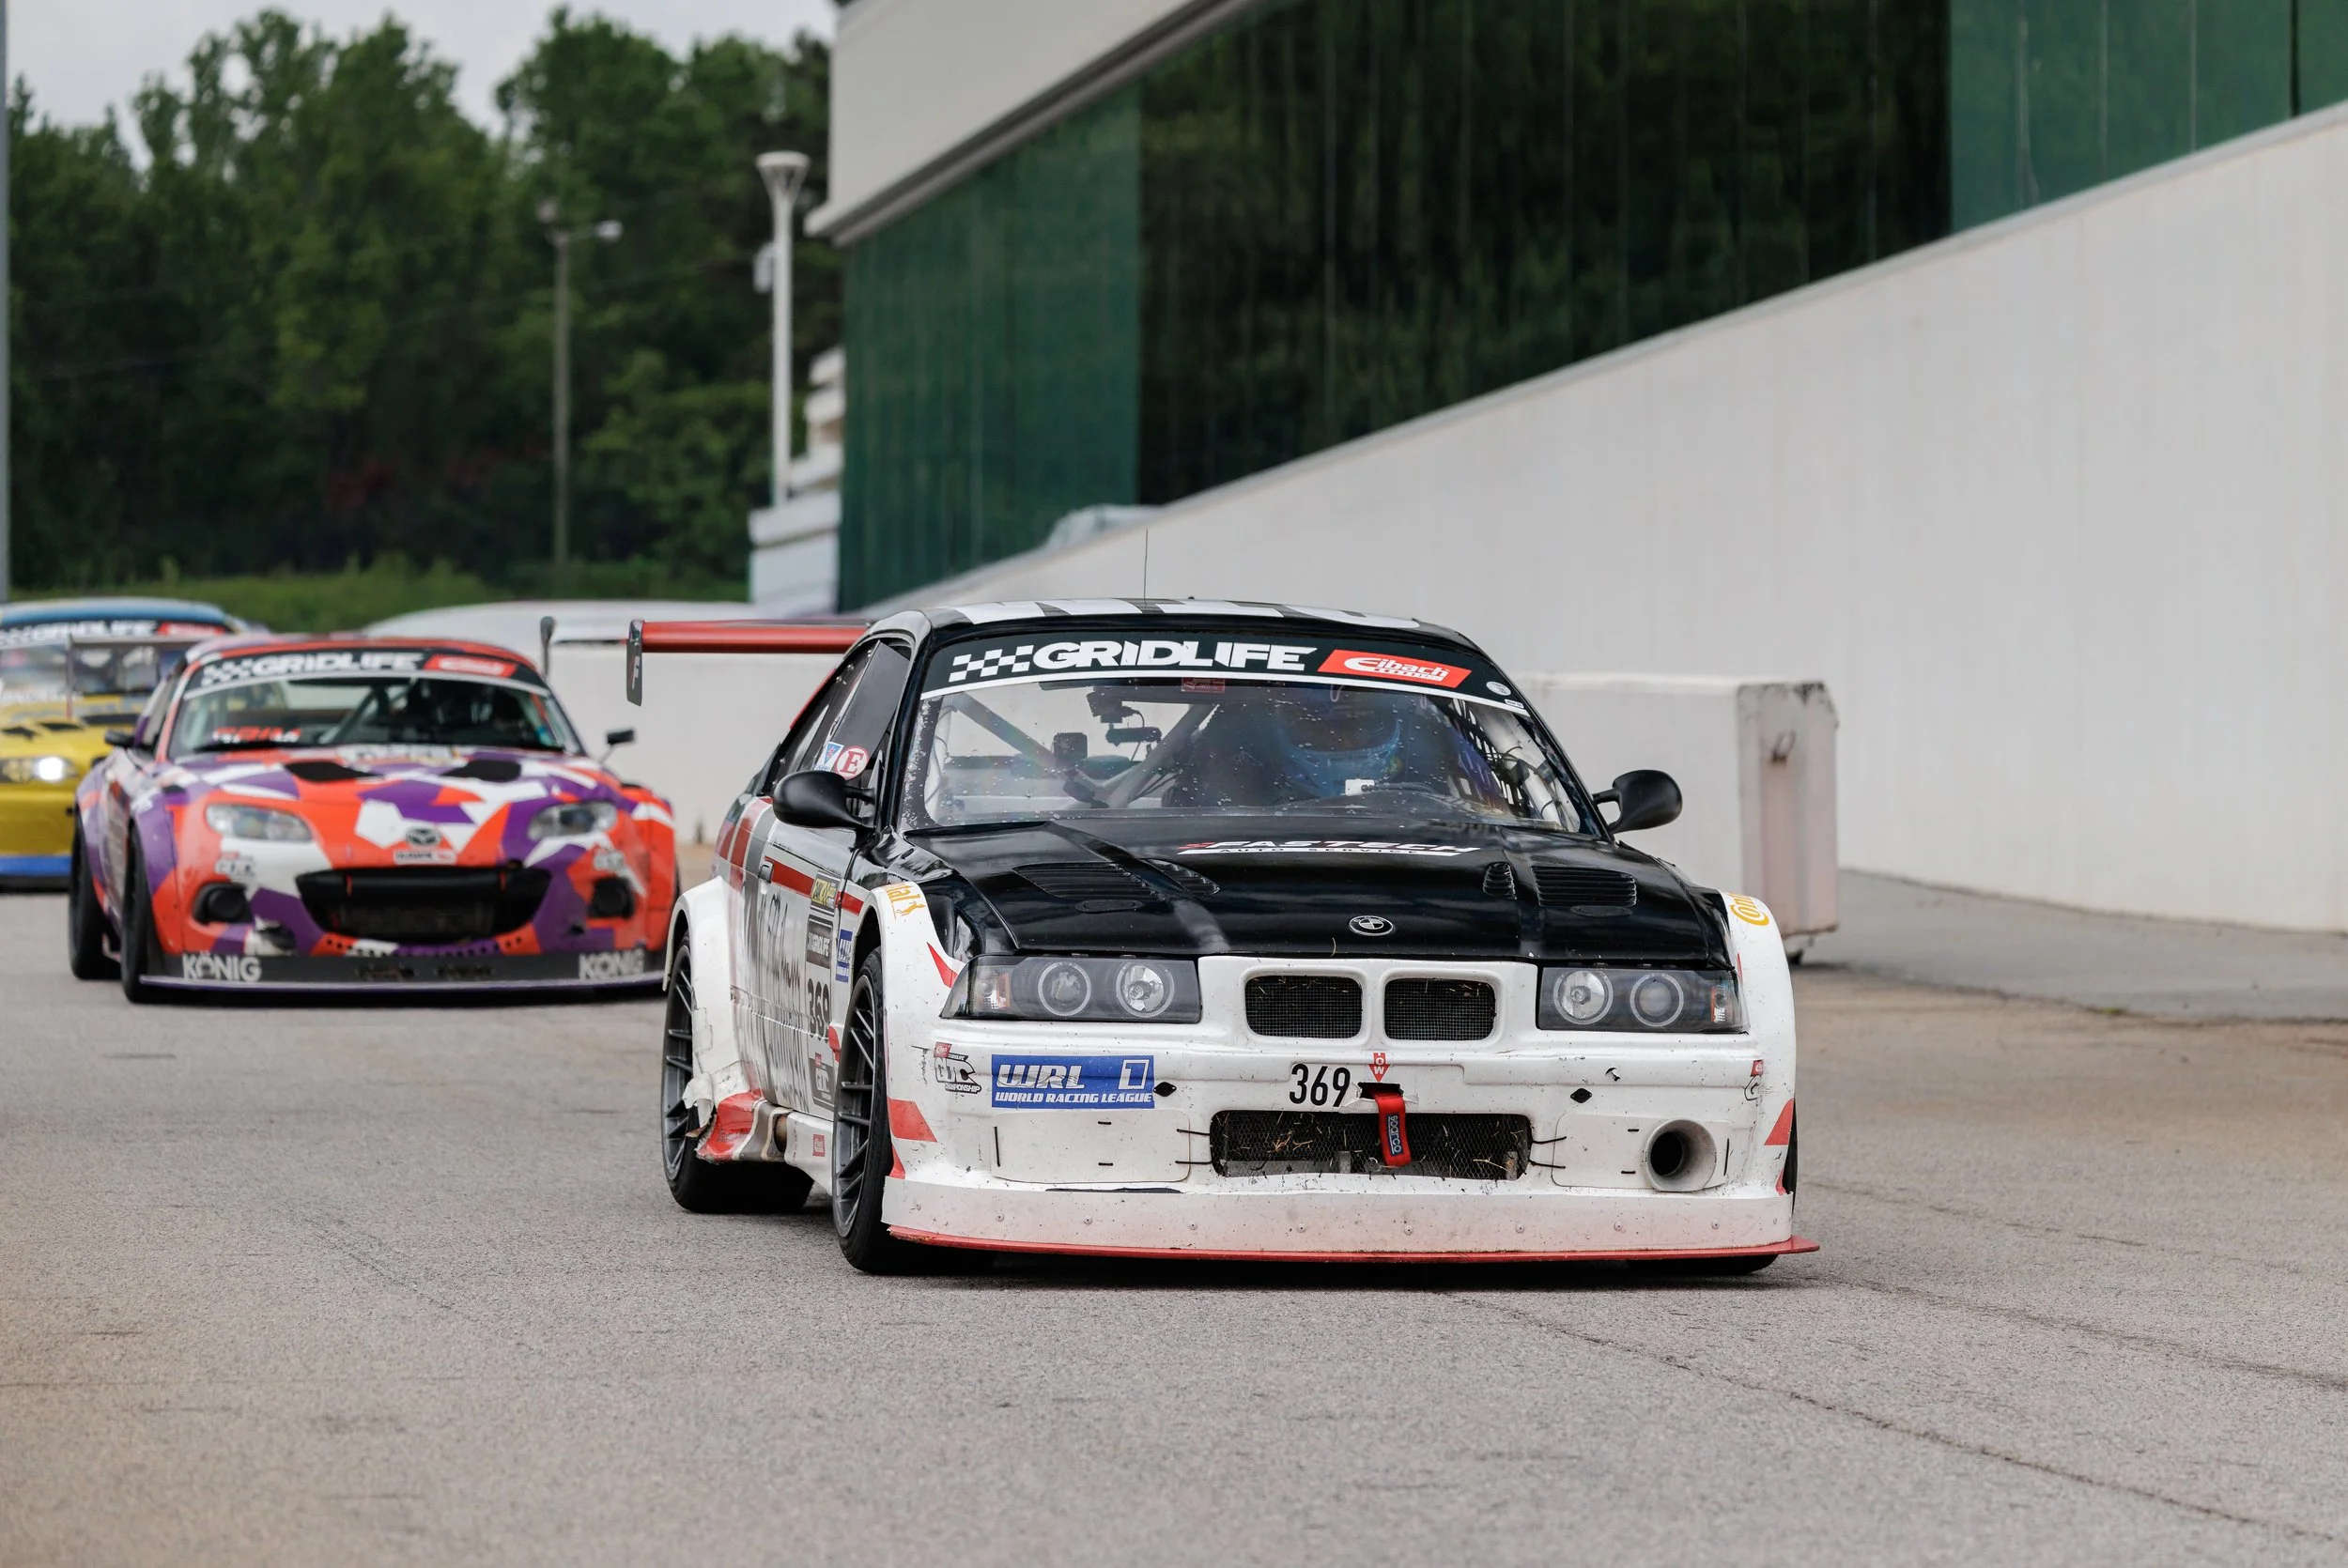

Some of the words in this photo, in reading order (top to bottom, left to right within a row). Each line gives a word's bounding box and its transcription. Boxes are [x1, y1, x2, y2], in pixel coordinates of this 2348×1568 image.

[252, 653, 423, 676] GRIDLIFE
[1033, 640, 1318, 671] GRIDLIFE
[1343, 656, 1449, 680] Eibach
[996, 1064, 1085, 1089] WRL
[1289, 1063, 1351, 1108] 369
[996, 1091, 1043, 1102] WORLD
[1045, 1093, 1099, 1103] RACING
[1101, 1092, 1152, 1103] LEAGUE
[1389, 1115, 1402, 1153] sparco
